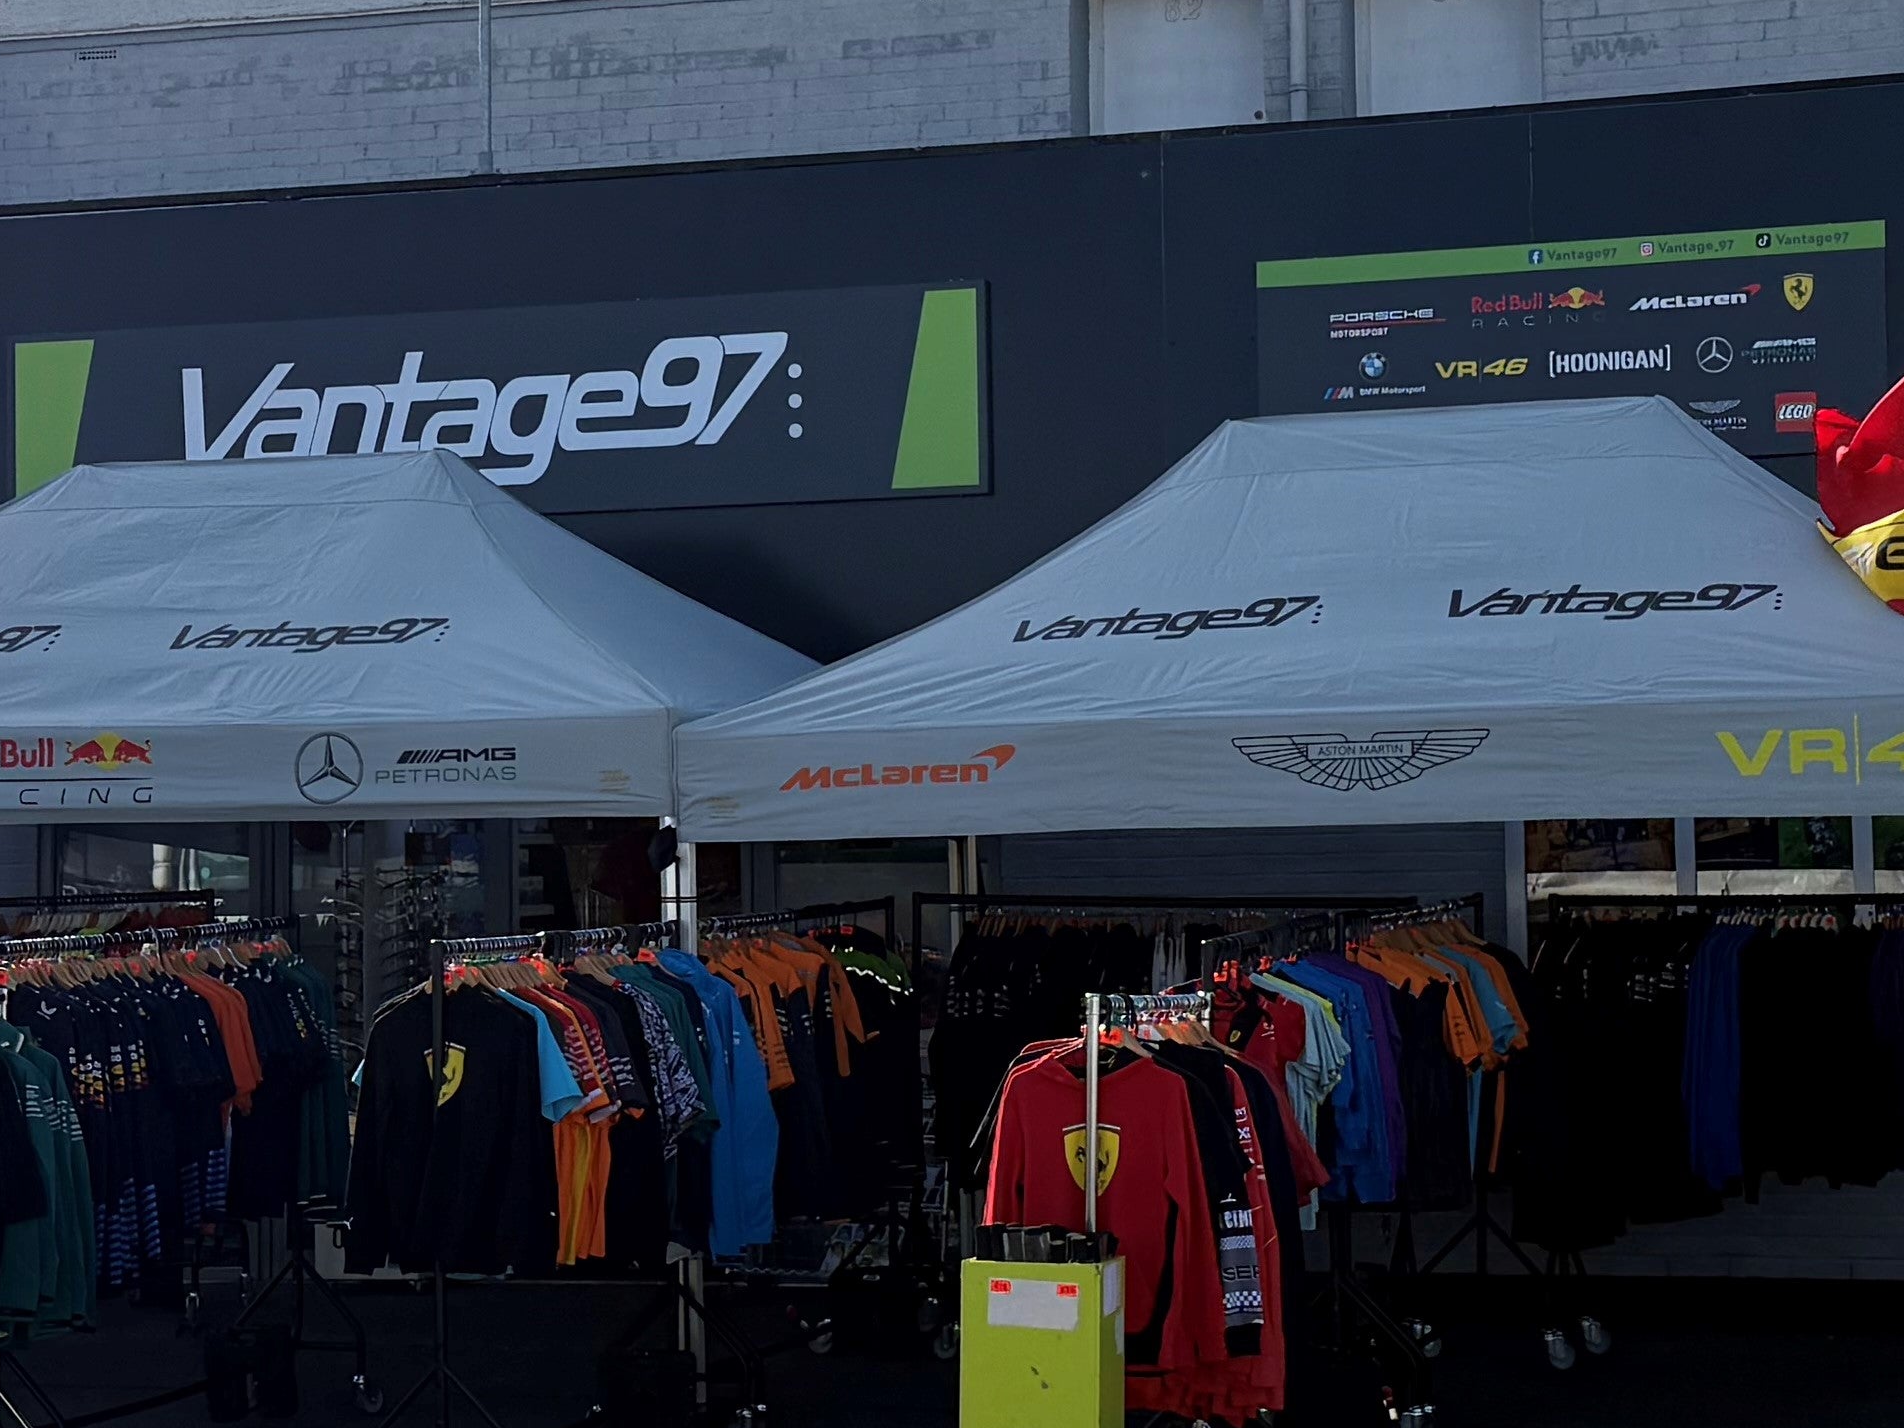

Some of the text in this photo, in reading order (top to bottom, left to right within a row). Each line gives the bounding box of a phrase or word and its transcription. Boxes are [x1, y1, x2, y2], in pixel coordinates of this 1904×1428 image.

[1774, 231, 1850, 247] Vantage97
[1547, 247, 1617, 263] Vantage97
[1471, 291, 1544, 314] Red Bull
[1629, 291, 1748, 313] McLaren
[1329, 308, 1434, 323] PORSCHE
[1472, 311, 1606, 329] RACING
[1330, 326, 1389, 339] MOTORSPORT
[1381, 384, 1427, 397] Motorsport
[183, 332, 788, 486] Vantage97
[1778, 404, 1814, 421] LEGO
[1449, 584, 1778, 621] Vantage97
[1012, 594, 1322, 643] Vantage97
[170, 618, 449, 654] Vantage97
[0, 737, 54, 768] Bull
[437, 746, 517, 763] AMG
[1317, 743, 1404, 757] ASTON MARTIN
[375, 766, 518, 785] PETRONAS
[779, 761, 989, 792] McLaren
